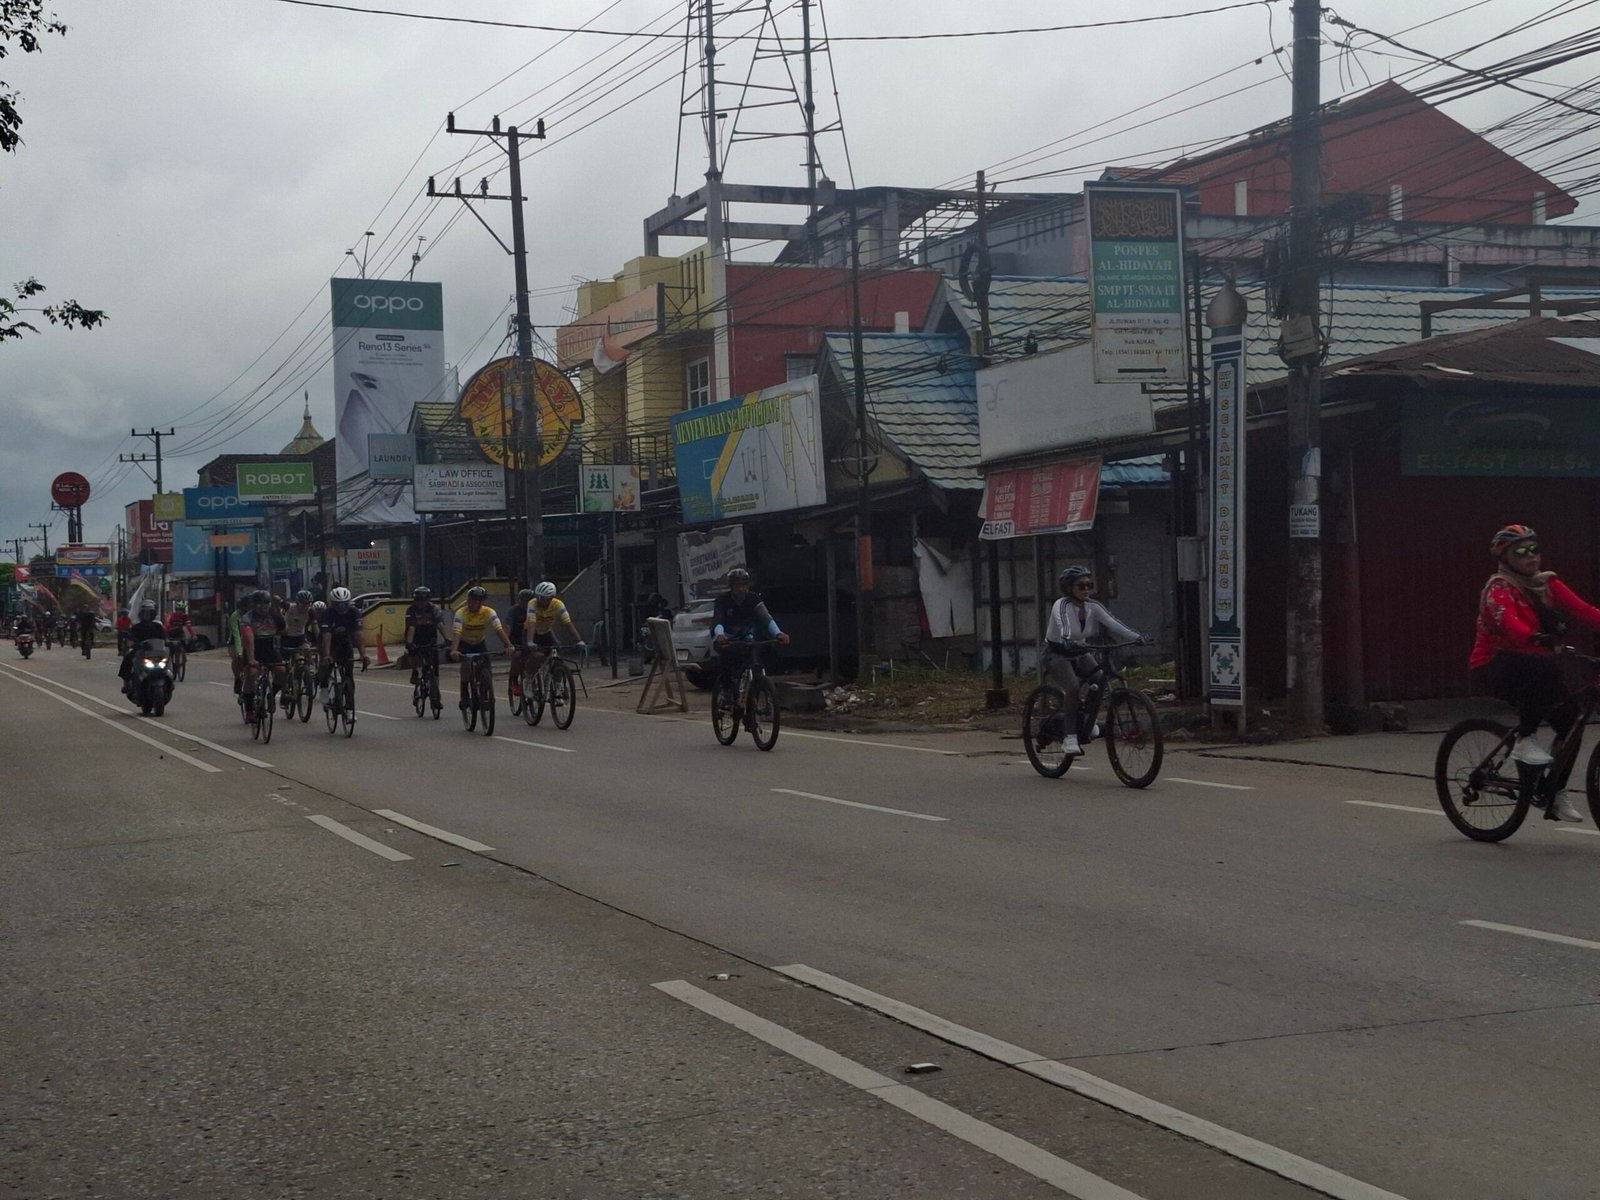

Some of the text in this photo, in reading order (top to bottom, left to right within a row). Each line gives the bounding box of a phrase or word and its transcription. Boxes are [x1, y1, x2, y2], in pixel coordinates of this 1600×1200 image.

[1113, 245, 1159, 256] PONPES
[1098, 260, 1172, 271] AL-HIDAYAH
[354, 294, 424, 314] oppo
[1106, 299, 1169, 308] AL-HIDAYAH
[358, 341, 393, 352] Reno13
[394, 343, 422, 353] Series
[1219, 399, 1231, 495] SELAMAT
[374, 455, 412, 463] LAUNDRY
[245, 472, 306, 485] ROBOT
[439, 470, 493, 478] LAW OFFICE
[466, 480, 504, 488] ASSOCIATES
[1291, 507, 1317, 517] TUKANG
[1219, 506, 1230, 589] DATANG
